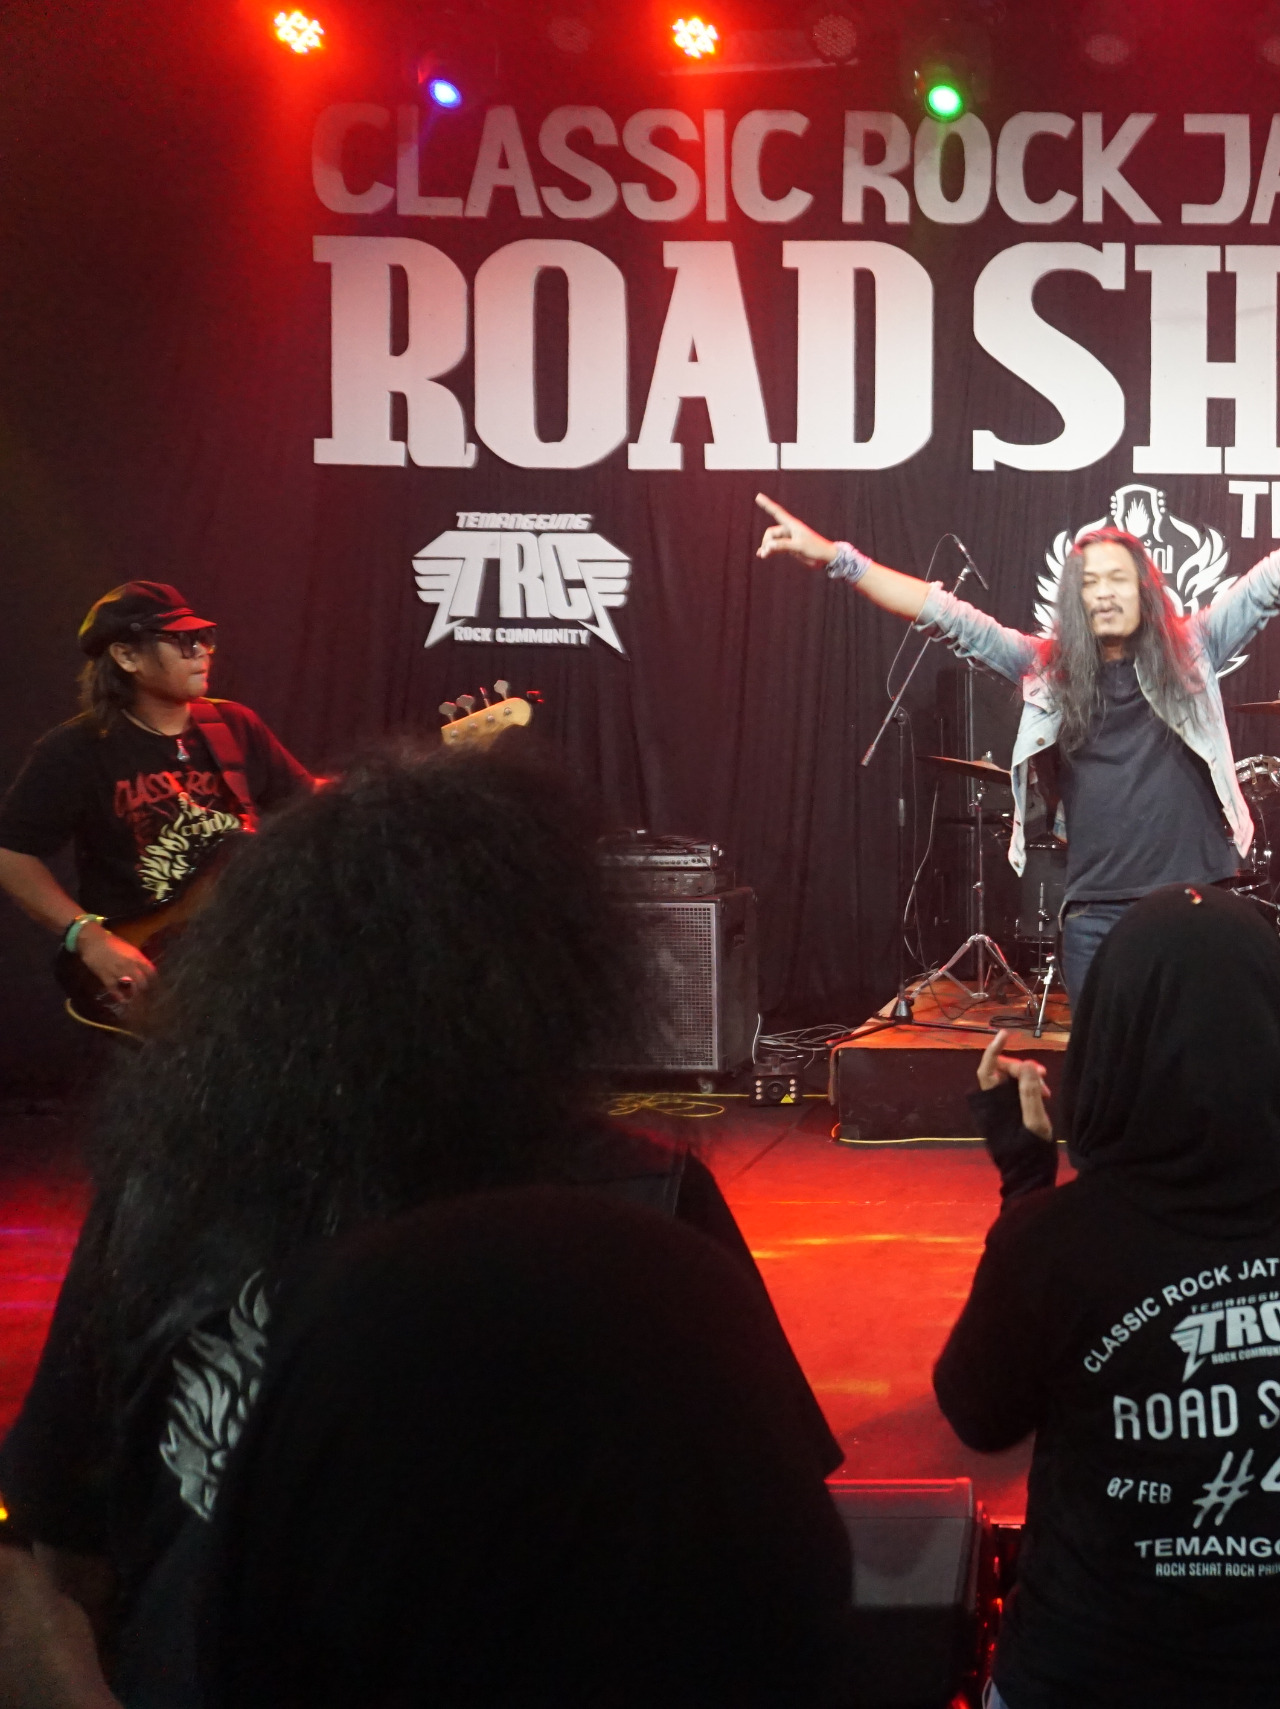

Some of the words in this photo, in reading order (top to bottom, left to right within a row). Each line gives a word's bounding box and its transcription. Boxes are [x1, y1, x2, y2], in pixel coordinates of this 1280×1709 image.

[312, 102, 814, 224] CLASSIC
[842, 111, 1161, 226] ROCK
[312, 235, 934, 470] ROAD
[456, 512, 592, 530] TEMANGGUNG
[454, 627, 493, 642] ROCK
[496, 628, 590, 645] COMMUNITY
[1083, 1297, 1161, 1374] CLASSIC
[1162, 1265, 1232, 1306] ROCK
[1211, 1352, 1237, 1365] ROCK
[1113, 1384, 1239, 1440] ROAD
[1106, 1476, 1134, 1500] 07
[1138, 1480, 1172, 1504] FEB
[1189, 1562, 1222, 1577] SEHAT
